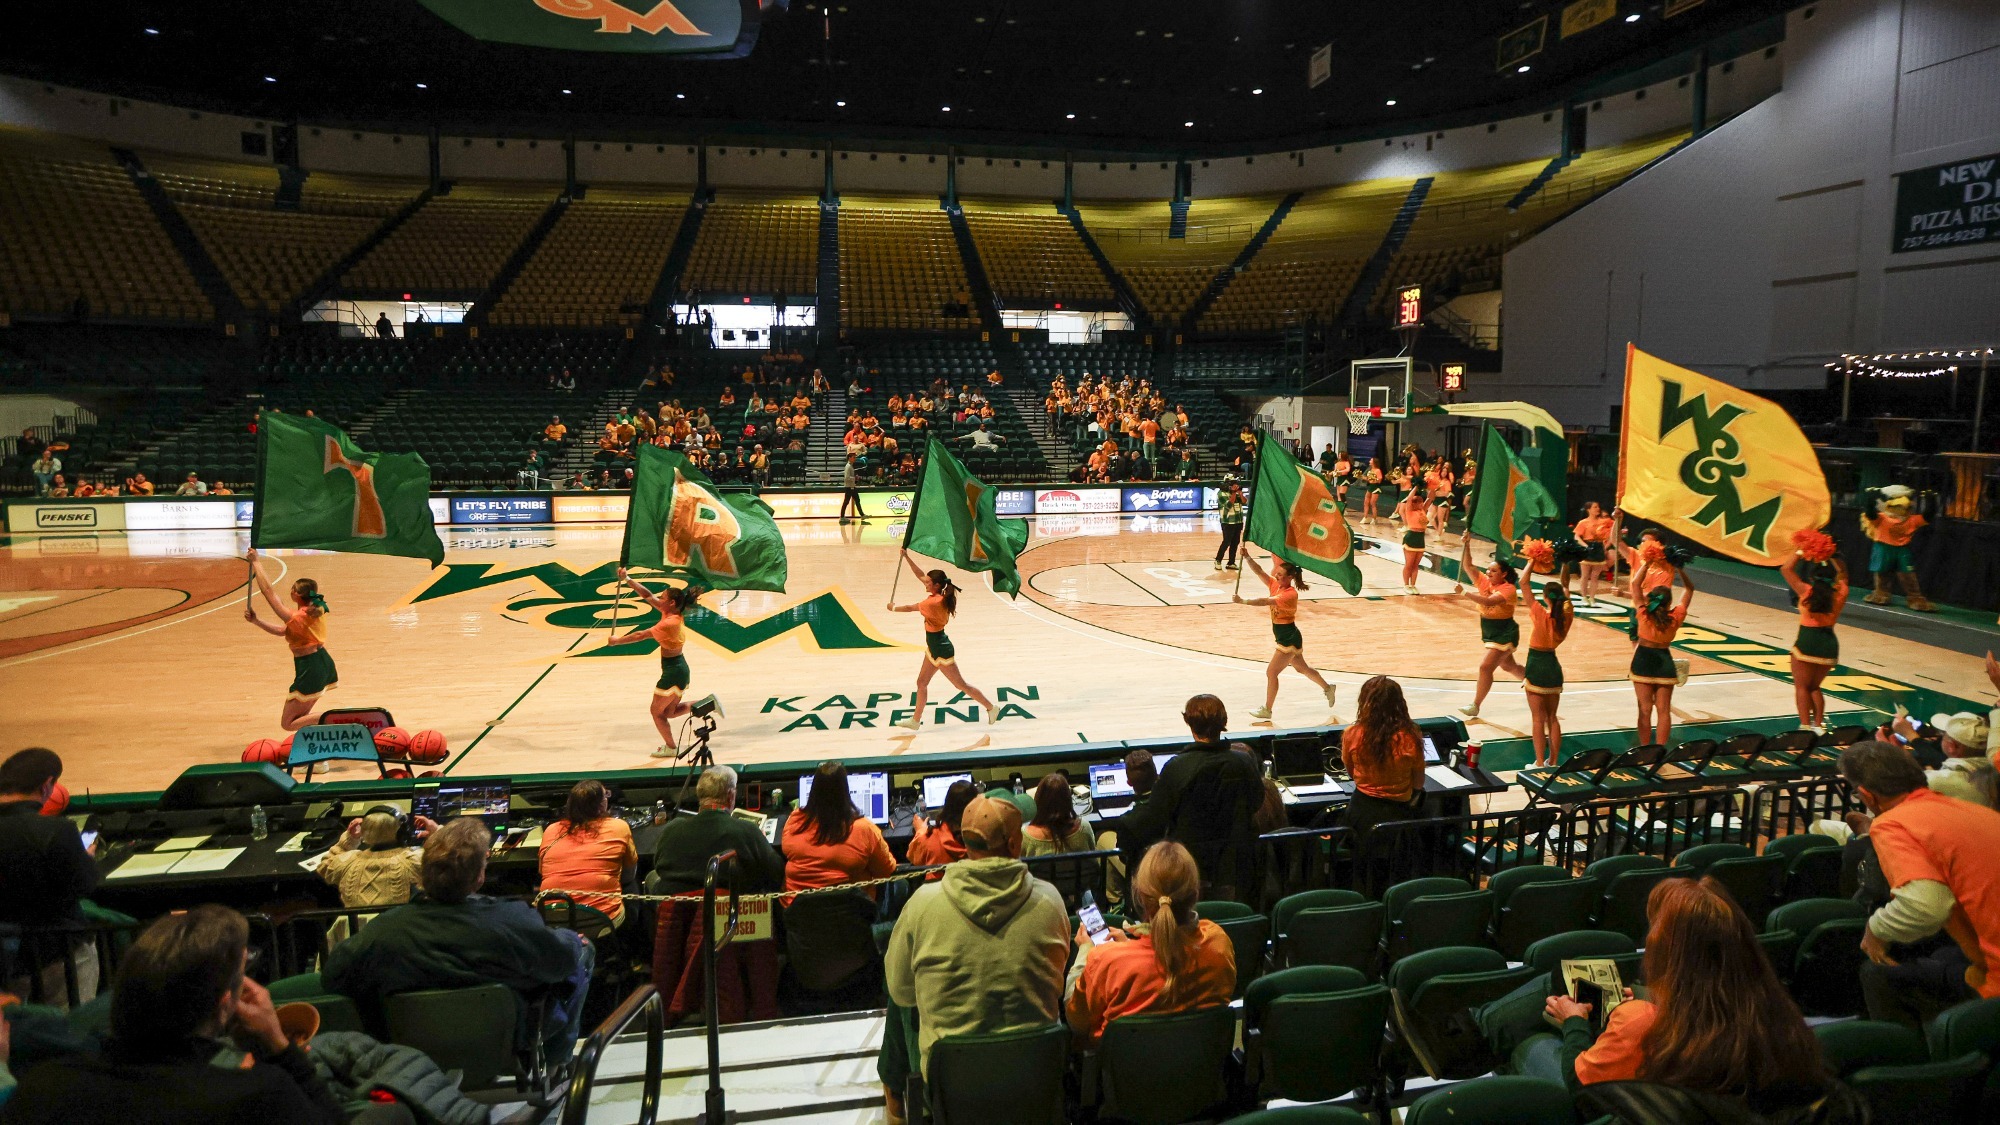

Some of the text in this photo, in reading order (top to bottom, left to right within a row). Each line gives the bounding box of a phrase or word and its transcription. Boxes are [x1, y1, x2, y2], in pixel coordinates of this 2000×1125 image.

[1939, 159, 1996, 187] NEW
[1911, 209, 1964, 232] PIZZA
[1401, 301, 1418, 323] 30
[1445, 376, 1460, 388] 30
[1658, 376, 1784, 557] W&M
[996, 491, 1024, 501] IBE!
[1044, 492, 1076, 501] Anna's
[1150, 489, 1194, 501] BayPort
[161, 503, 200, 513] BARNES
[455, 501, 546, 511] LET'S FLY, TRIBE
[41, 513, 92, 521] PENSKE
[1285, 464, 1351, 563] B
[663, 467, 741, 579] R
[302, 730, 363, 741] WILLIAM
[308, 741, 360, 755] &MARY
[716, 900, 768, 916] HIS ECTION
